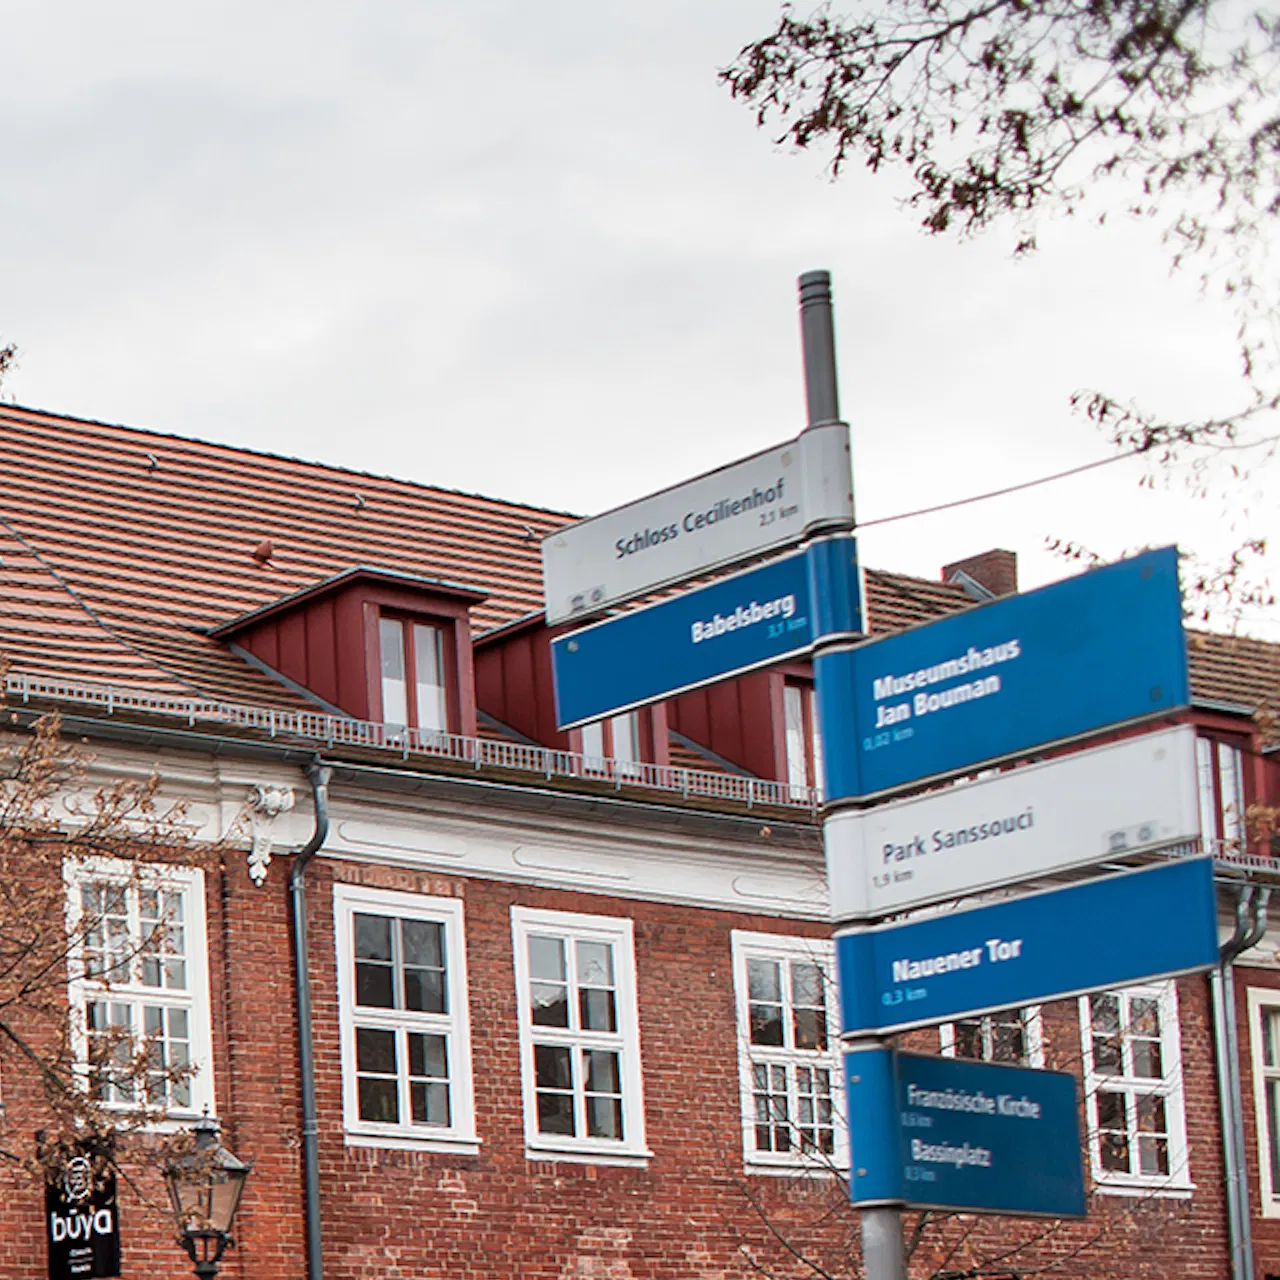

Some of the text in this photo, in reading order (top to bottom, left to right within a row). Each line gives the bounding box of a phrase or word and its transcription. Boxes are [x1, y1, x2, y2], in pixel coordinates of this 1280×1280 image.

[615, 478, 785, 559] Schloss Cecilienhof
[779, 504, 799, 519] km
[691, 595, 797, 644] Babelsberg
[787, 616, 809, 632] km
[873, 639, 1022, 701] Museumshaus
[875, 675, 1002, 729] Jan Bouman
[892, 727, 914, 743] km
[883, 806, 1034, 864] Park Sanssouci
[893, 869, 914, 883] km
[893, 938, 1024, 983] Nauener Tor
[905, 987, 929, 1003] km
[906, 1083, 1041, 1119] Französische Kirche
[910, 1138, 992, 1169] Bassinplatz
[51, 1207, 113, 1242] būya
